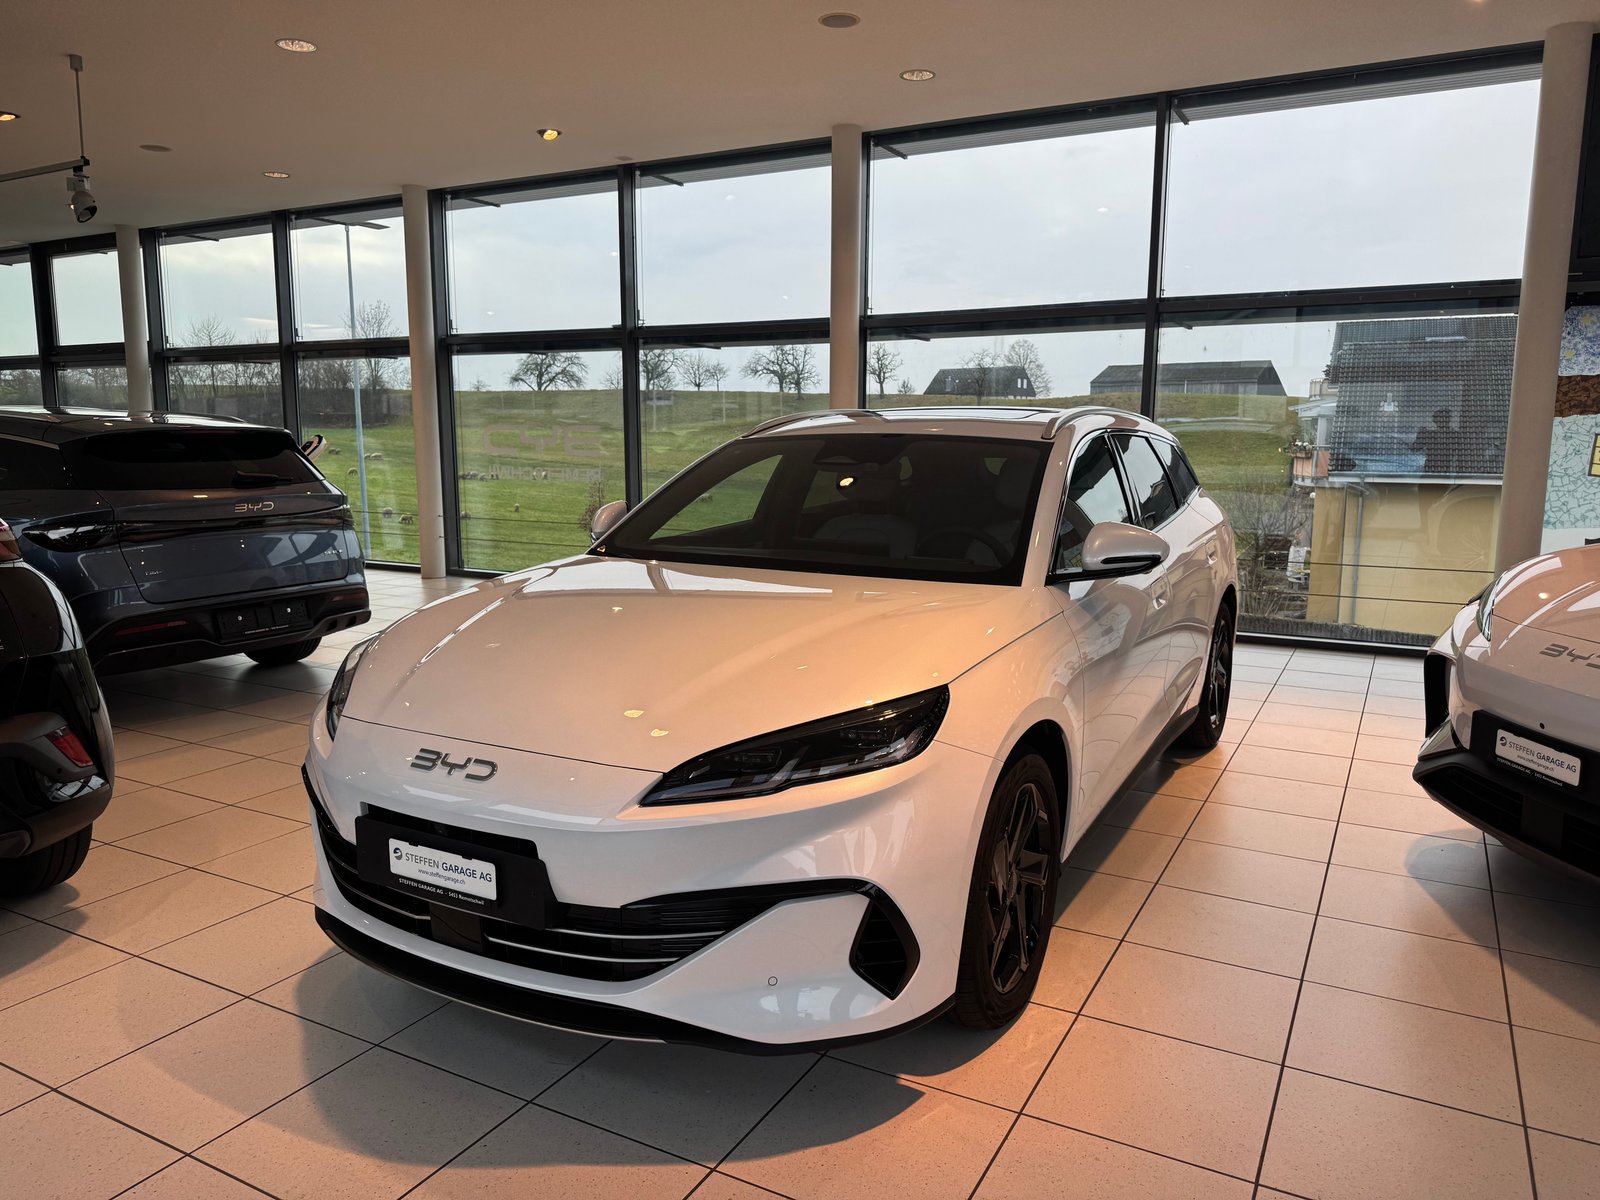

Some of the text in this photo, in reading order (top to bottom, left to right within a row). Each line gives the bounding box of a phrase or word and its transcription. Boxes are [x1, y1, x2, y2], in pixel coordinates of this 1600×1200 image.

[234, 501, 275, 513] BYD
[410, 747, 499, 781] BYD
[1508, 741, 1577, 773] STEFFEN GARAGE AG
[405, 852, 493, 883] STEFFEN GARAGE AG
[418, 868, 466, 885] www.steffengarage.ch
[399, 877, 418, 888] STEFFEN
[418, 883, 436, 892] GARAGE
